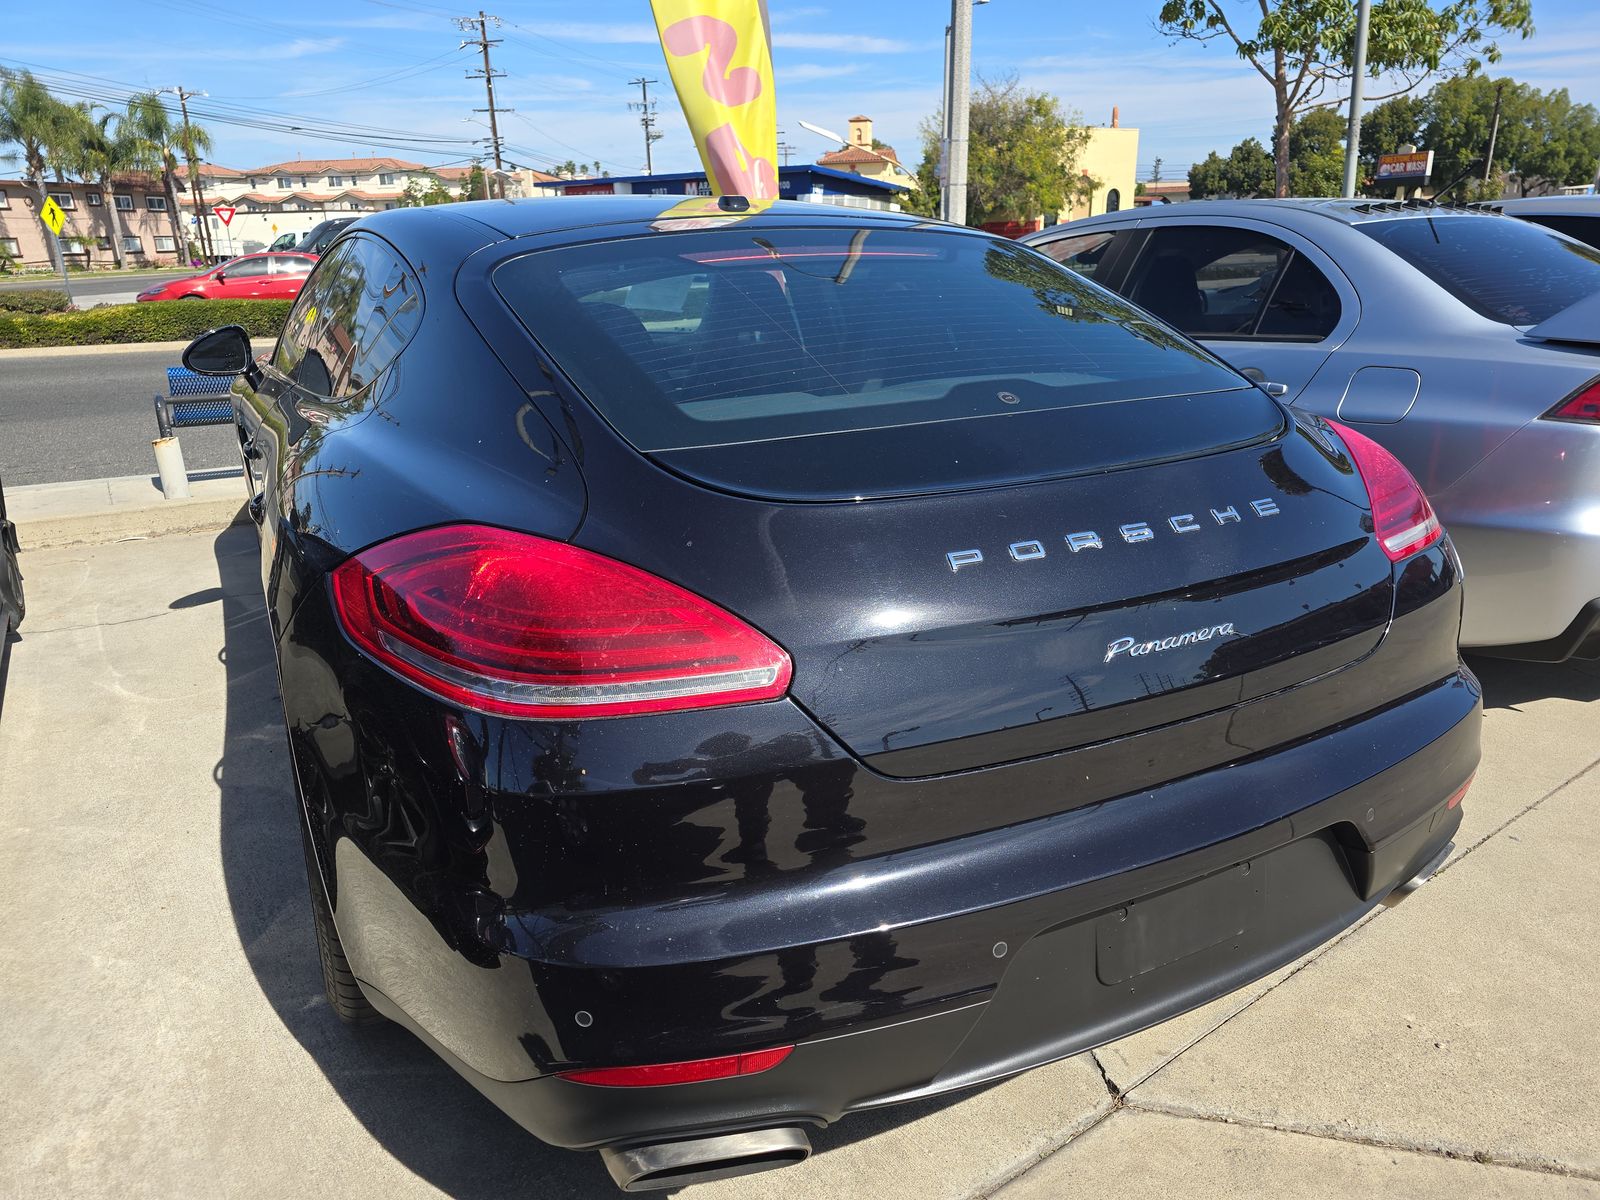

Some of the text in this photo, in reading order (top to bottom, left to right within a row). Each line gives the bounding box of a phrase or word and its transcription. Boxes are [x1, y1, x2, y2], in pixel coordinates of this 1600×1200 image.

[1390, 160, 1427, 173] CAR WASH
[945, 497, 1280, 574] PORSCHE
[1103, 621, 1241, 664] Panamera
